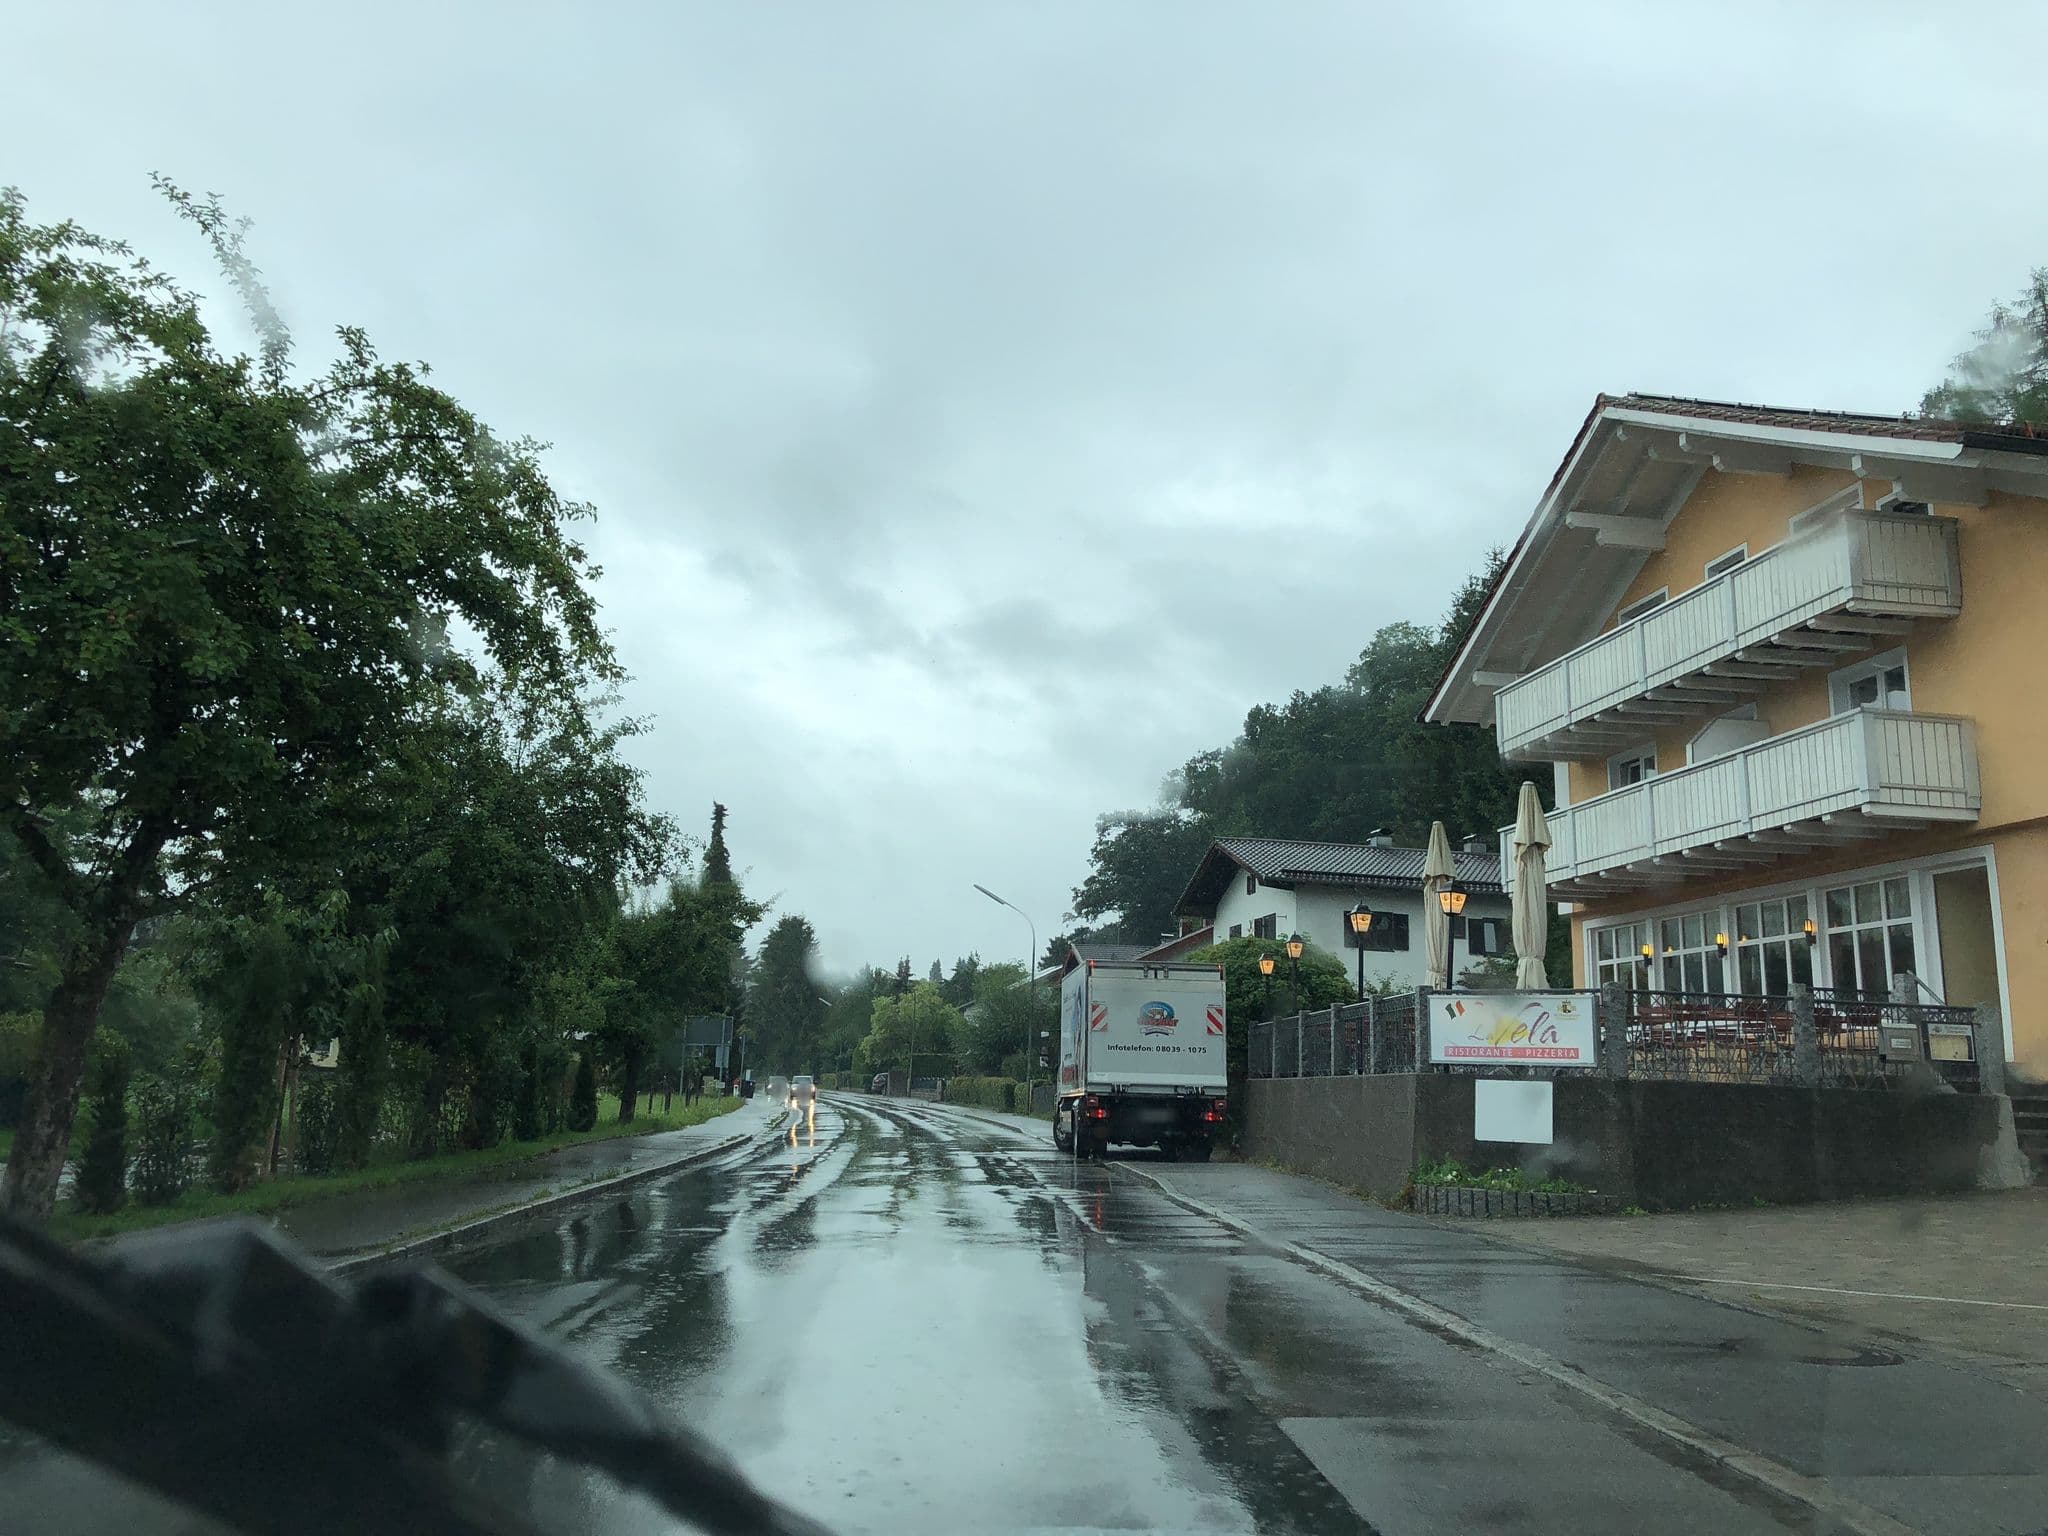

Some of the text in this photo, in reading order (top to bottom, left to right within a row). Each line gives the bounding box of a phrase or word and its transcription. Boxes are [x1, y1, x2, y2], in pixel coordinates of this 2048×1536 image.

[1107, 1044, 1154, 1052] Infotelefon:
[1448, 1047, 1513, 1057] RISTORANTE
[1526, 1048, 1577, 1058] PIZZERIA
